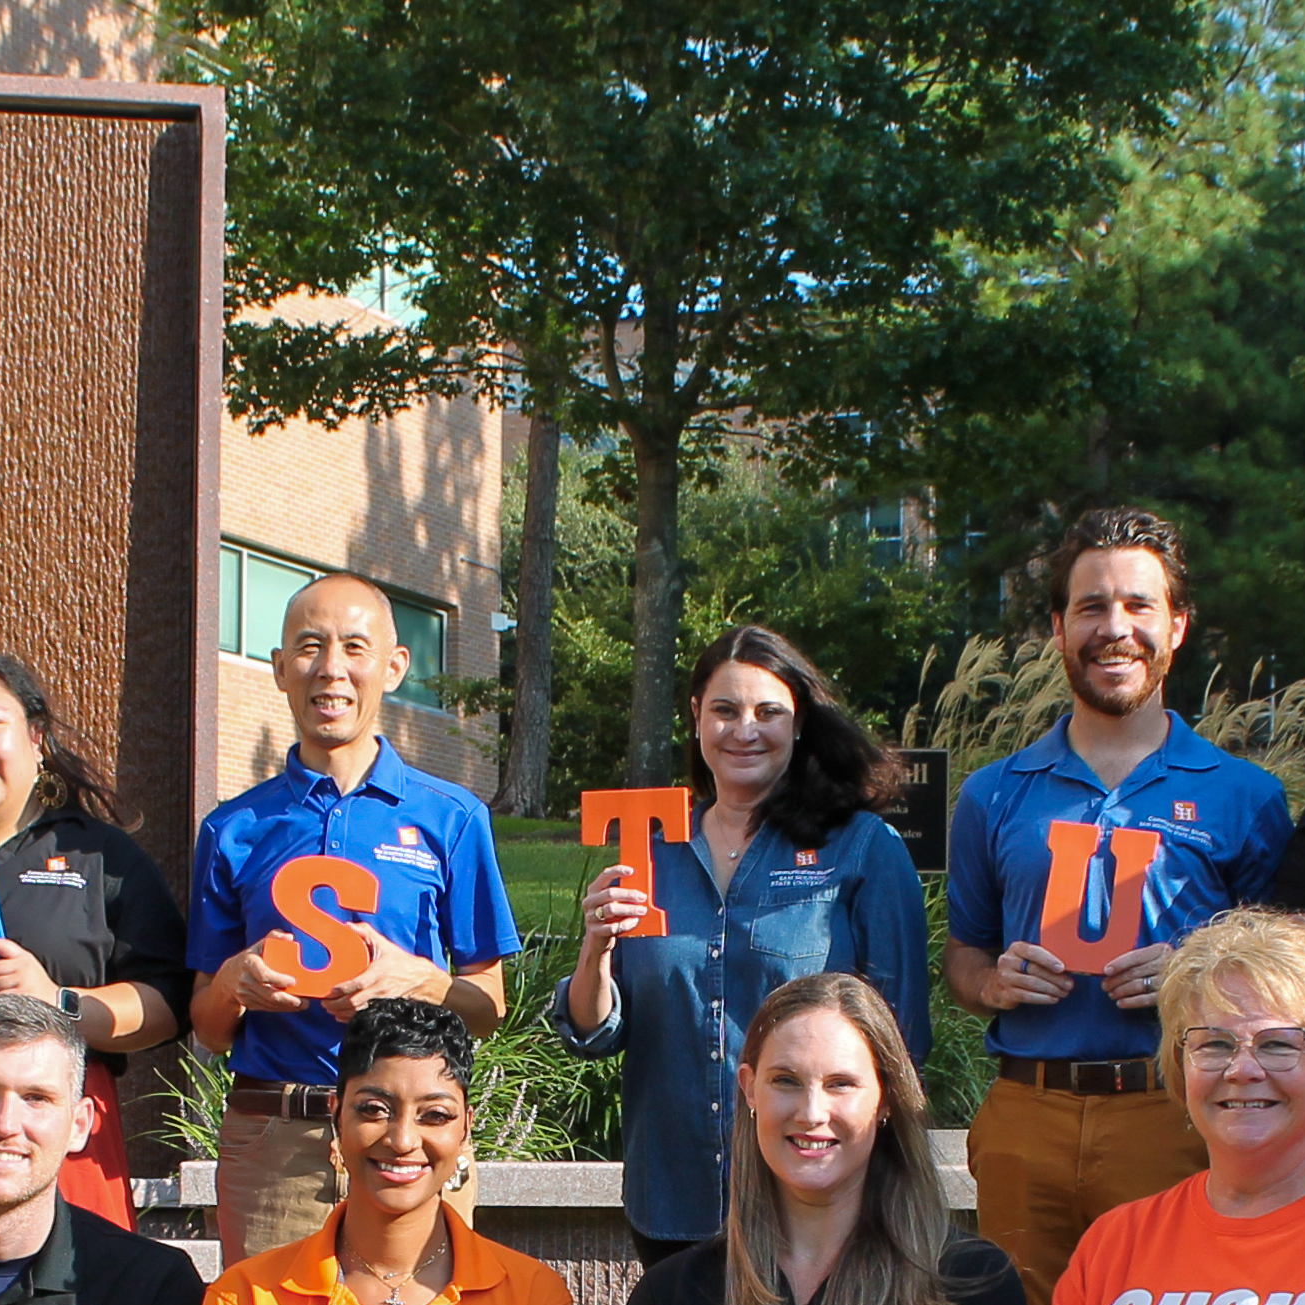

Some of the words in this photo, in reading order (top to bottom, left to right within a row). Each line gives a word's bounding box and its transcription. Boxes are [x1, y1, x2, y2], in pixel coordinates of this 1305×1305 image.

[262, 854, 379, 998] S
[581, 787, 692, 938] T
[1040, 820, 1161, 975] U
